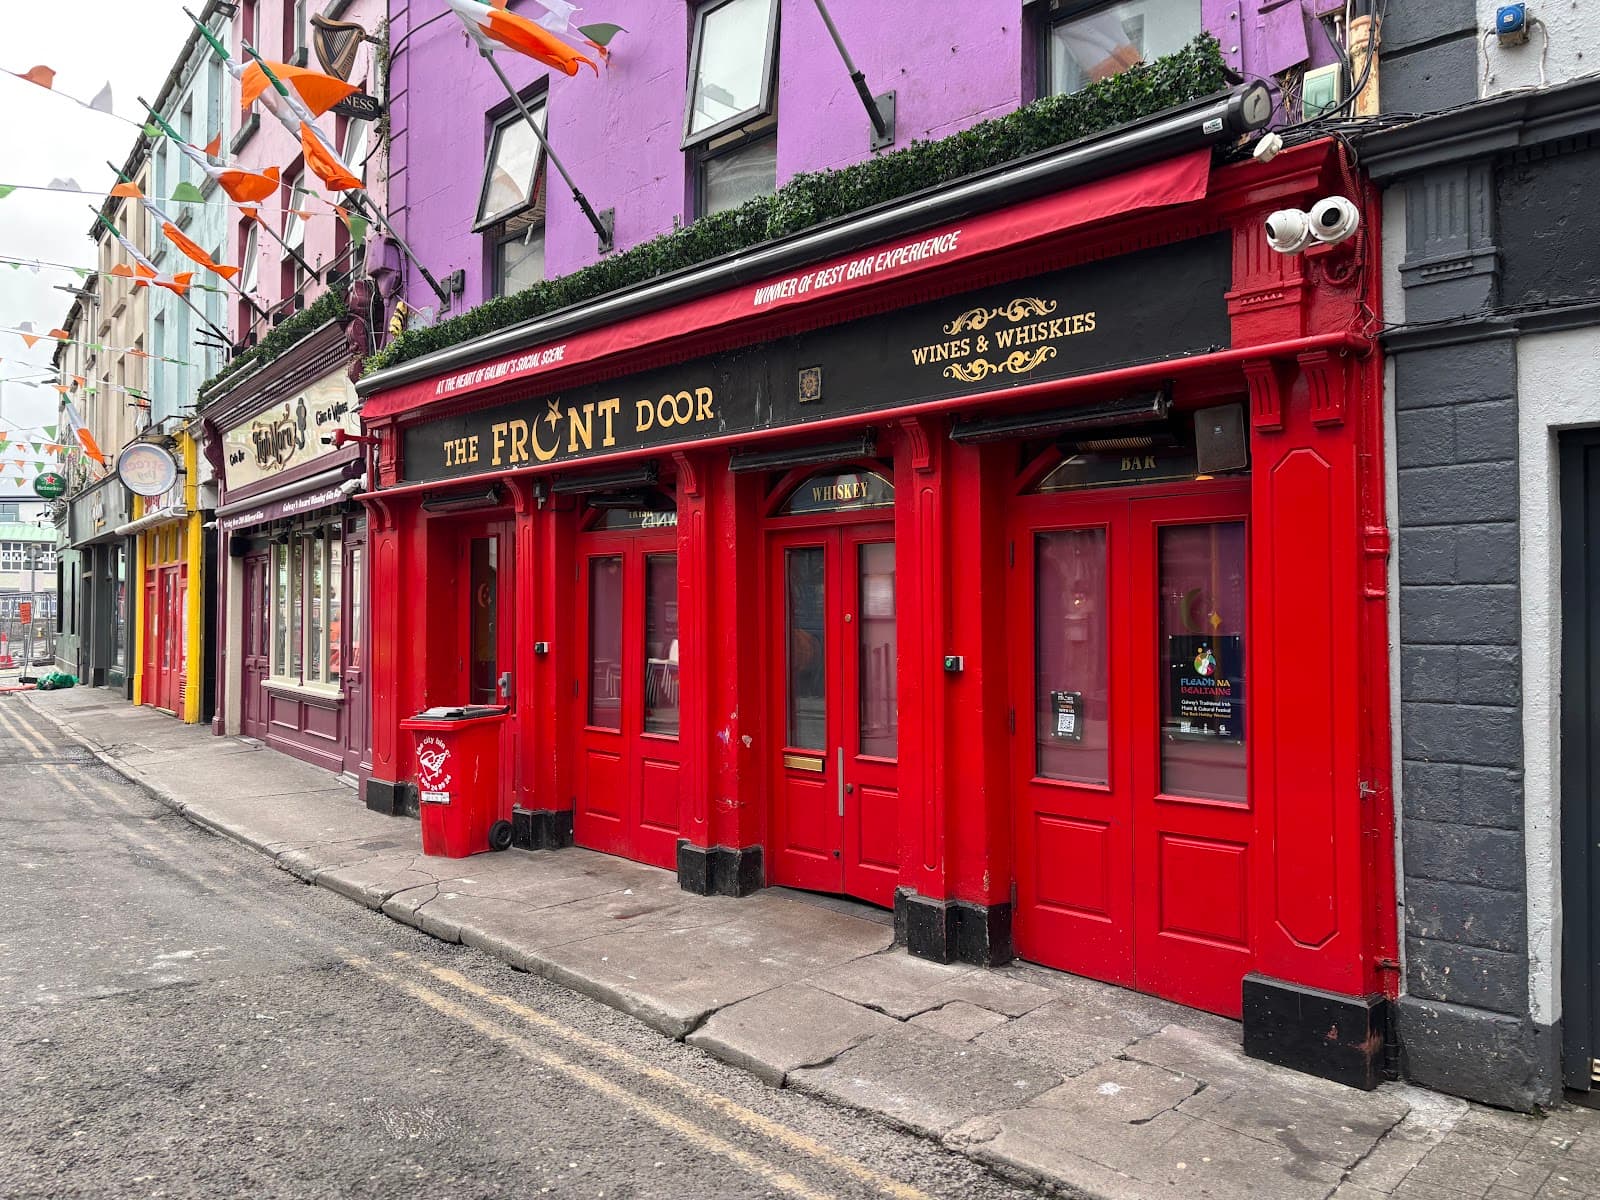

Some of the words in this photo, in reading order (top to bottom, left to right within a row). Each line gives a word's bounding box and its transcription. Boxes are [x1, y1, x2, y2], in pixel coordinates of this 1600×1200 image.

[342, 95, 375, 112] NESS
[753, 277, 798, 306] WINNER
[798, 272, 816, 294] OF
[814, 264, 850, 289] BEST
[847, 255, 874, 280] BAR
[874, 230, 962, 273] EXPERIENCE
[911, 337, 971, 366] WINES
[976, 335, 989, 353] &
[995, 311, 1097, 349] WHISKIES
[436, 380, 444, 395] AT
[445, 376, 457, 392] THE
[455, 371, 478, 390] HEART
[475, 368, 486, 383] OF
[484, 359, 517, 380] GALWAY'S
[516, 352, 542, 372] SOCIAL
[540, 344, 567, 365] SCENE
[443, 434, 479, 467] THE
[491, 397, 620, 467] FRONT
[635, 386, 715, 433] DOOR
[1120, 456, 1157, 471] BAR
[812, 481, 868, 503] WHISKEY
[1180, 687, 1232, 697] BEALTAINE
[423, 736, 434, 745] city
